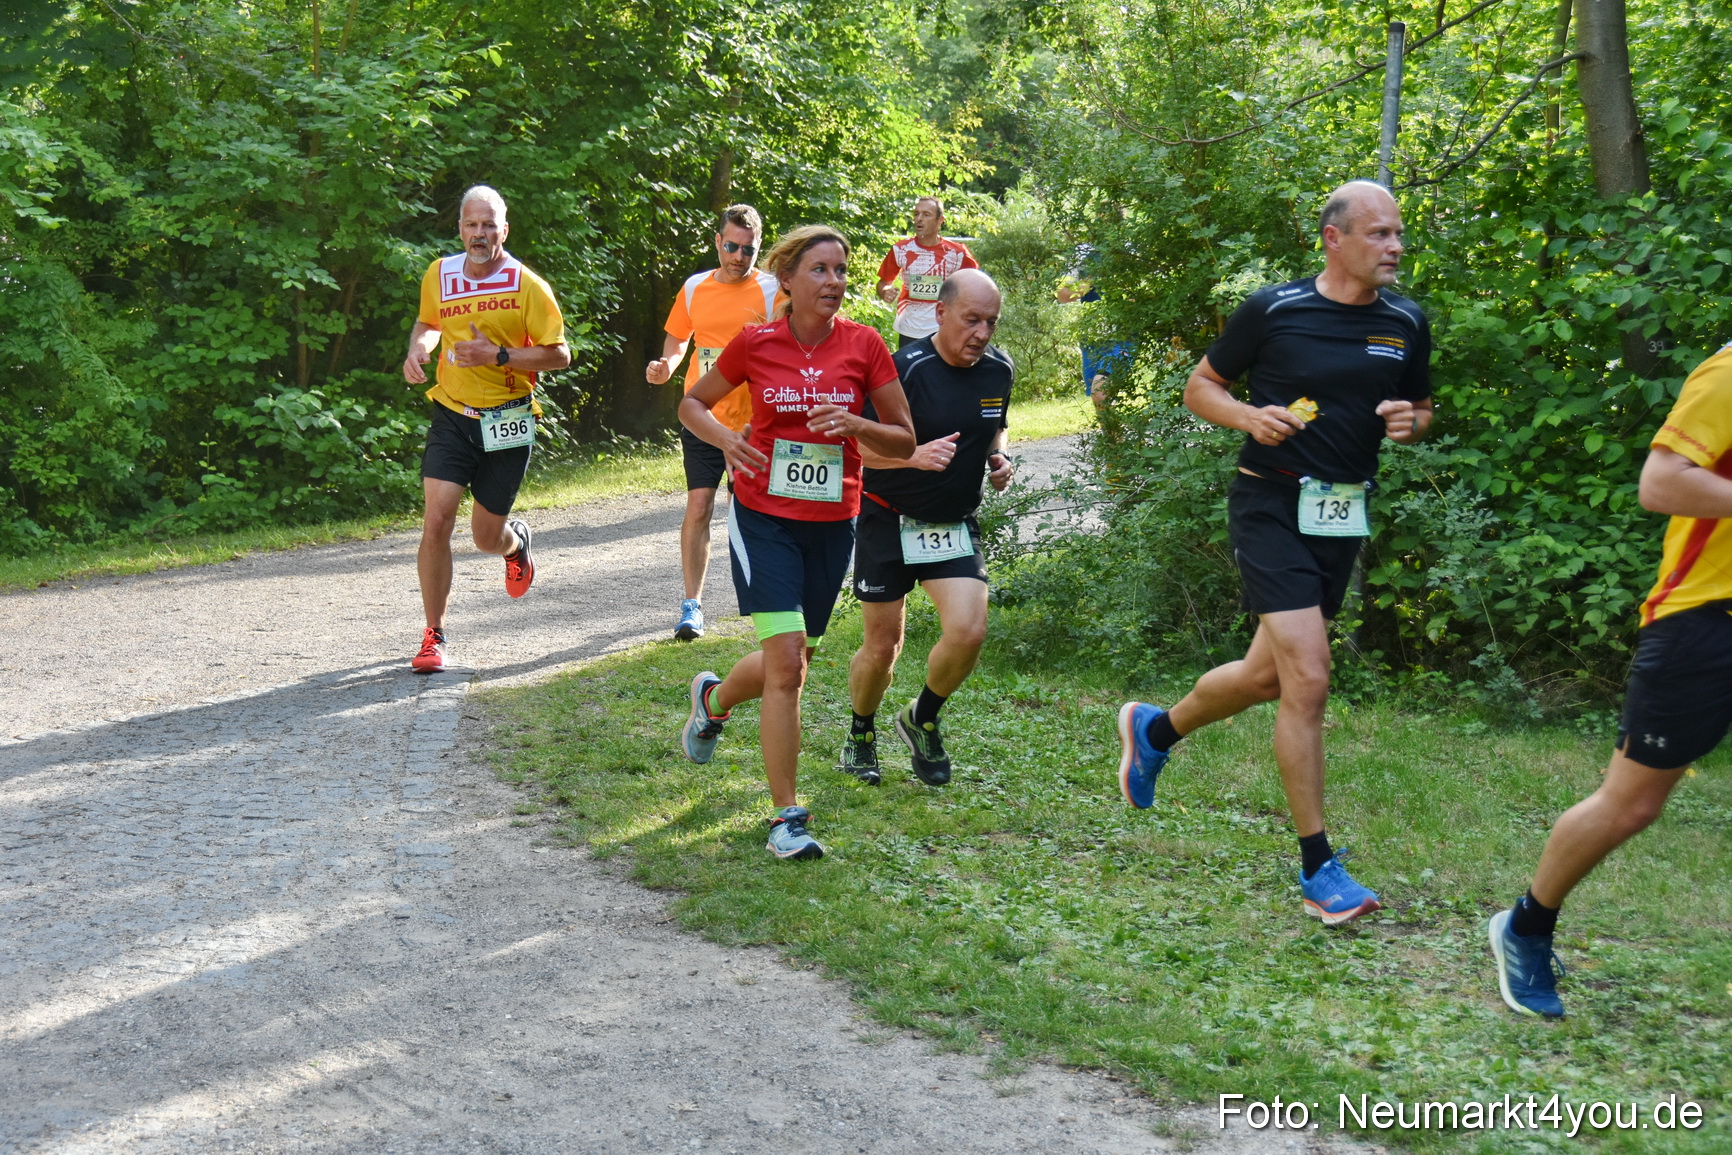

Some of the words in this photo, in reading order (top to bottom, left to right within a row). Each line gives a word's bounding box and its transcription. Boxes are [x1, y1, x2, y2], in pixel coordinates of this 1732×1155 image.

[913, 283, 938, 294] 2223
[440, 303, 473, 319] MAX
[478, 297, 521, 312] BÖGL
[763, 386, 802, 404] Echtes
[776, 404, 809, 413] IMMER
[489, 420, 528, 439] 1596
[786, 462, 828, 485] 600
[1315, 499, 1351, 520] 138
[916, 531, 953, 550] 131
